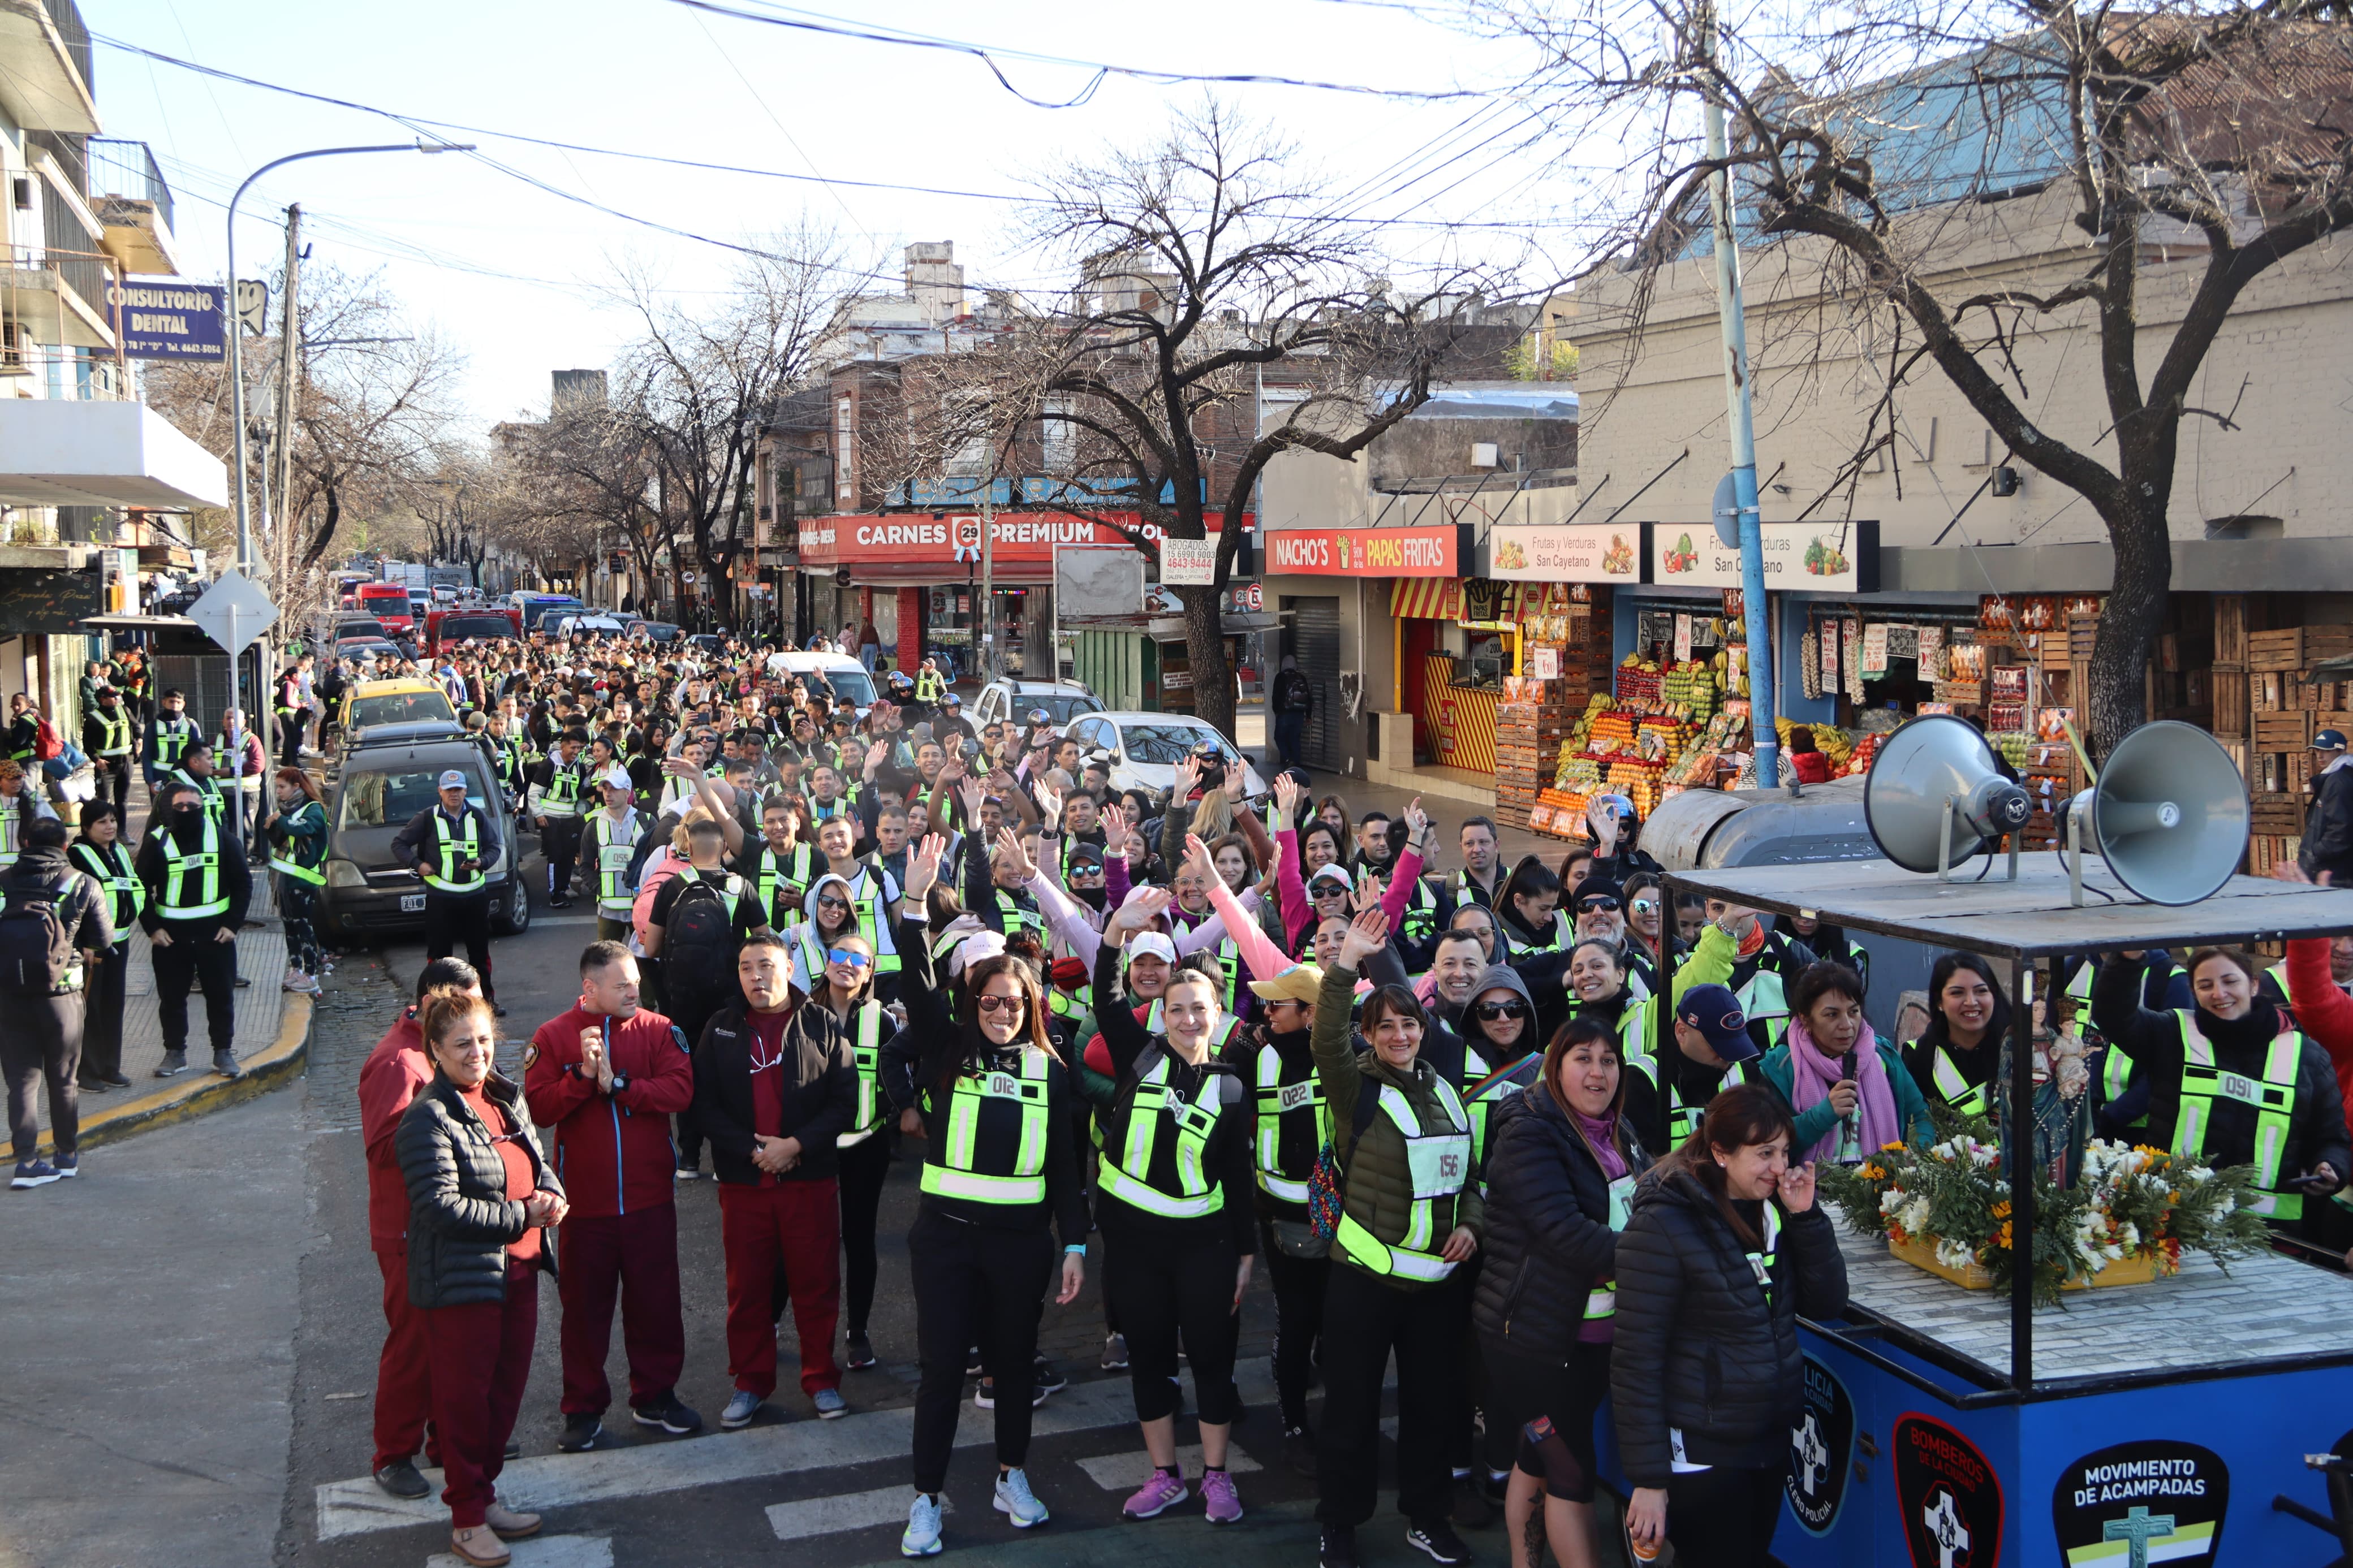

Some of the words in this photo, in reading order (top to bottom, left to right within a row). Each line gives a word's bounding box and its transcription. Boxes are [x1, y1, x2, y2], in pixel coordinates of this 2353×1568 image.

[107, 287, 213, 312] CONSULTORIO
[131, 313, 189, 335] DENTAL
[166, 343, 180, 352] Tel.
[857, 525, 947, 545] CARNES
[962, 526, 978, 538] 29
[992, 522, 1094, 543] PREMIUM
[1353, 537, 1357, 546] el
[1533, 537, 1555, 549] Frutas
[1557, 540, 1561, 552] y
[1563, 537, 1596, 549] Verduras
[1761, 536, 1790, 551] rduras
[1167, 540, 1209, 550] ABOGADOS
[1276, 538, 1329, 566] NACHO'S
[1367, 539, 1402, 567] PAPAS
[1403, 537, 1442, 567] FRITAS
[1353, 547, 1363, 558] SHOW
[1536, 554, 1552, 567] San
[1553, 554, 1589, 569] Cayetano
[1715, 557, 1733, 572] San
[1736, 558, 1782, 573] Cano
[933, 598, 946, 607] 29
[1490, 643, 1502, 653] 2000
[2253, 755, 2262, 791] FRUTAS
[993, 1076, 1015, 1095] 012
[1283, 1085, 1307, 1107] 022
[2226, 1075, 2251, 1099] 091
[1440, 1155, 1458, 1177] 156
[1805, 1364, 1833, 1400] LICIA
[1911, 1426, 1984, 1484] BOMBEROS
[1919, 1450, 1930, 1464] DE
[1932, 1455, 1942, 1471] LA
[1944, 1460, 1976, 1493] CIUDAD
[2085, 1459, 2195, 1485] MOVIMIENTO
[1787, 1475, 1804, 1513] CLERO
[1805, 1500, 1832, 1522] POLICIAL
[2074, 1487, 2097, 1507] DE
[2100, 1479, 2205, 1502] ACAMPADAS
